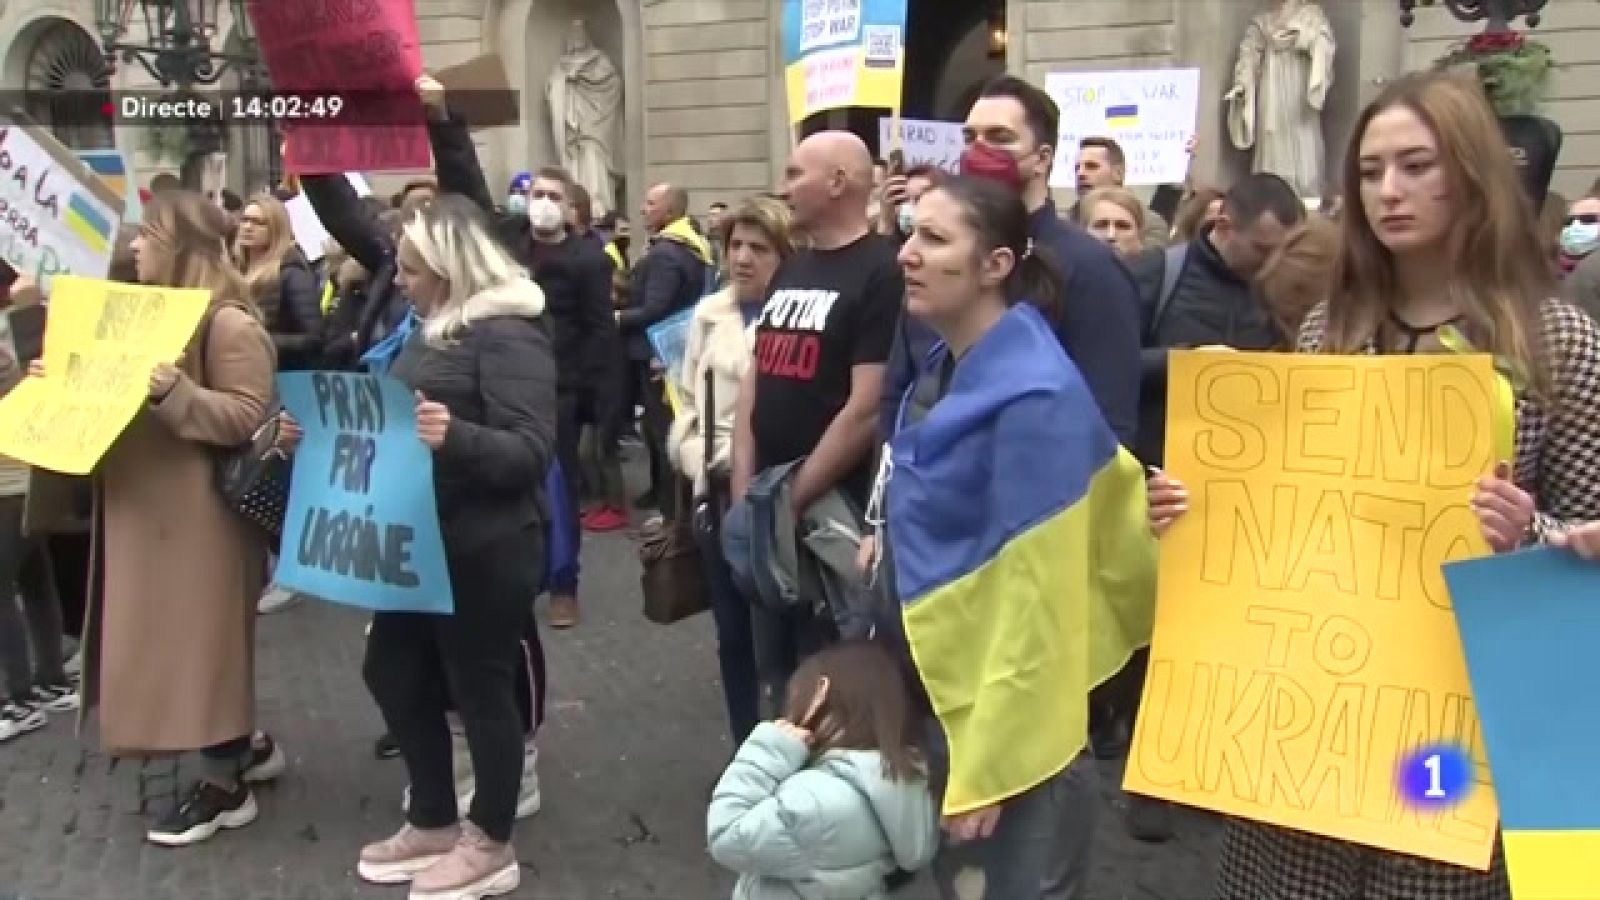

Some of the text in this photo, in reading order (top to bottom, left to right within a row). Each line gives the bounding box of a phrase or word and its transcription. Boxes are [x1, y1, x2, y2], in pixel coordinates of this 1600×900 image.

[829, 15, 856, 36] WAR
[1063, 85, 1106, 104] STOP
[1141, 82, 1179, 101] WAR
[760, 289, 840, 330] PUTIN
[312, 371, 386, 433] PRAY
[1194, 363, 1490, 488] SEND
[330, 434, 376, 494] FOR
[1247, 606, 1372, 675] TO
